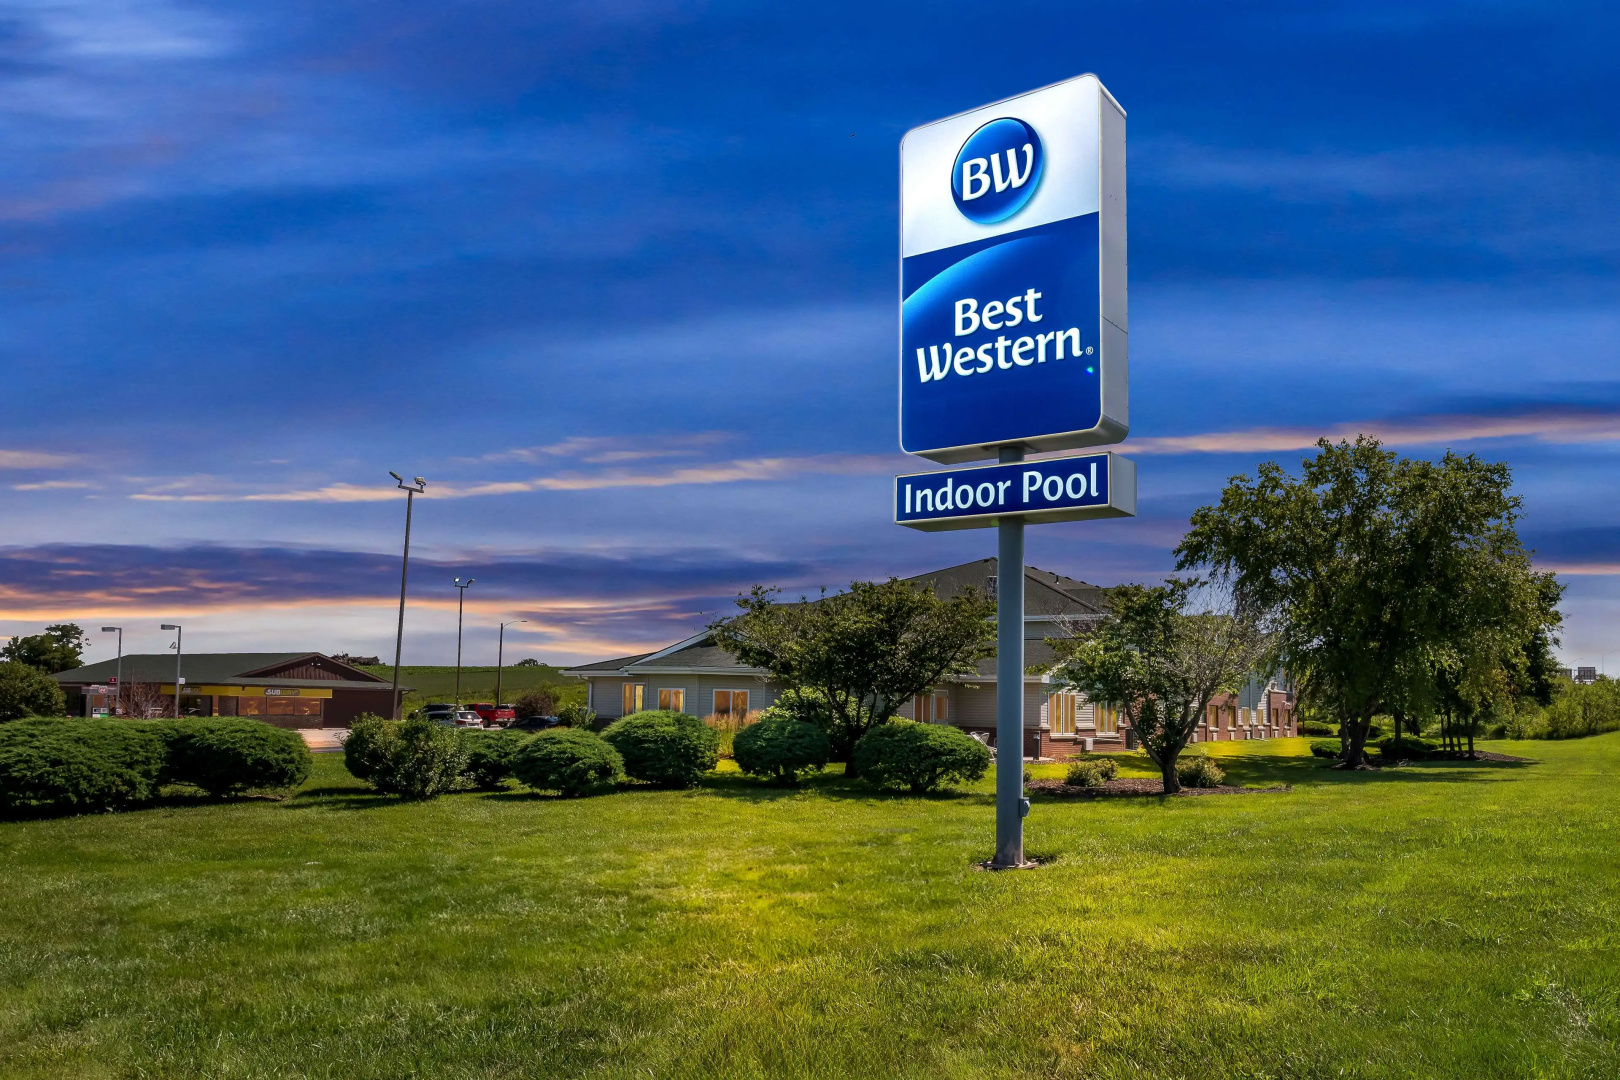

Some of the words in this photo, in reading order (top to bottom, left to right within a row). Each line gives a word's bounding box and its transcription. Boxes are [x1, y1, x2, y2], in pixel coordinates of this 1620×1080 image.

[962, 143, 1034, 201] BW
[954, 288, 1043, 337] Best
[916, 327, 1084, 383] Western
[904, 480, 1011, 514] Indoor
[1022, 462, 1099, 503] Pool
